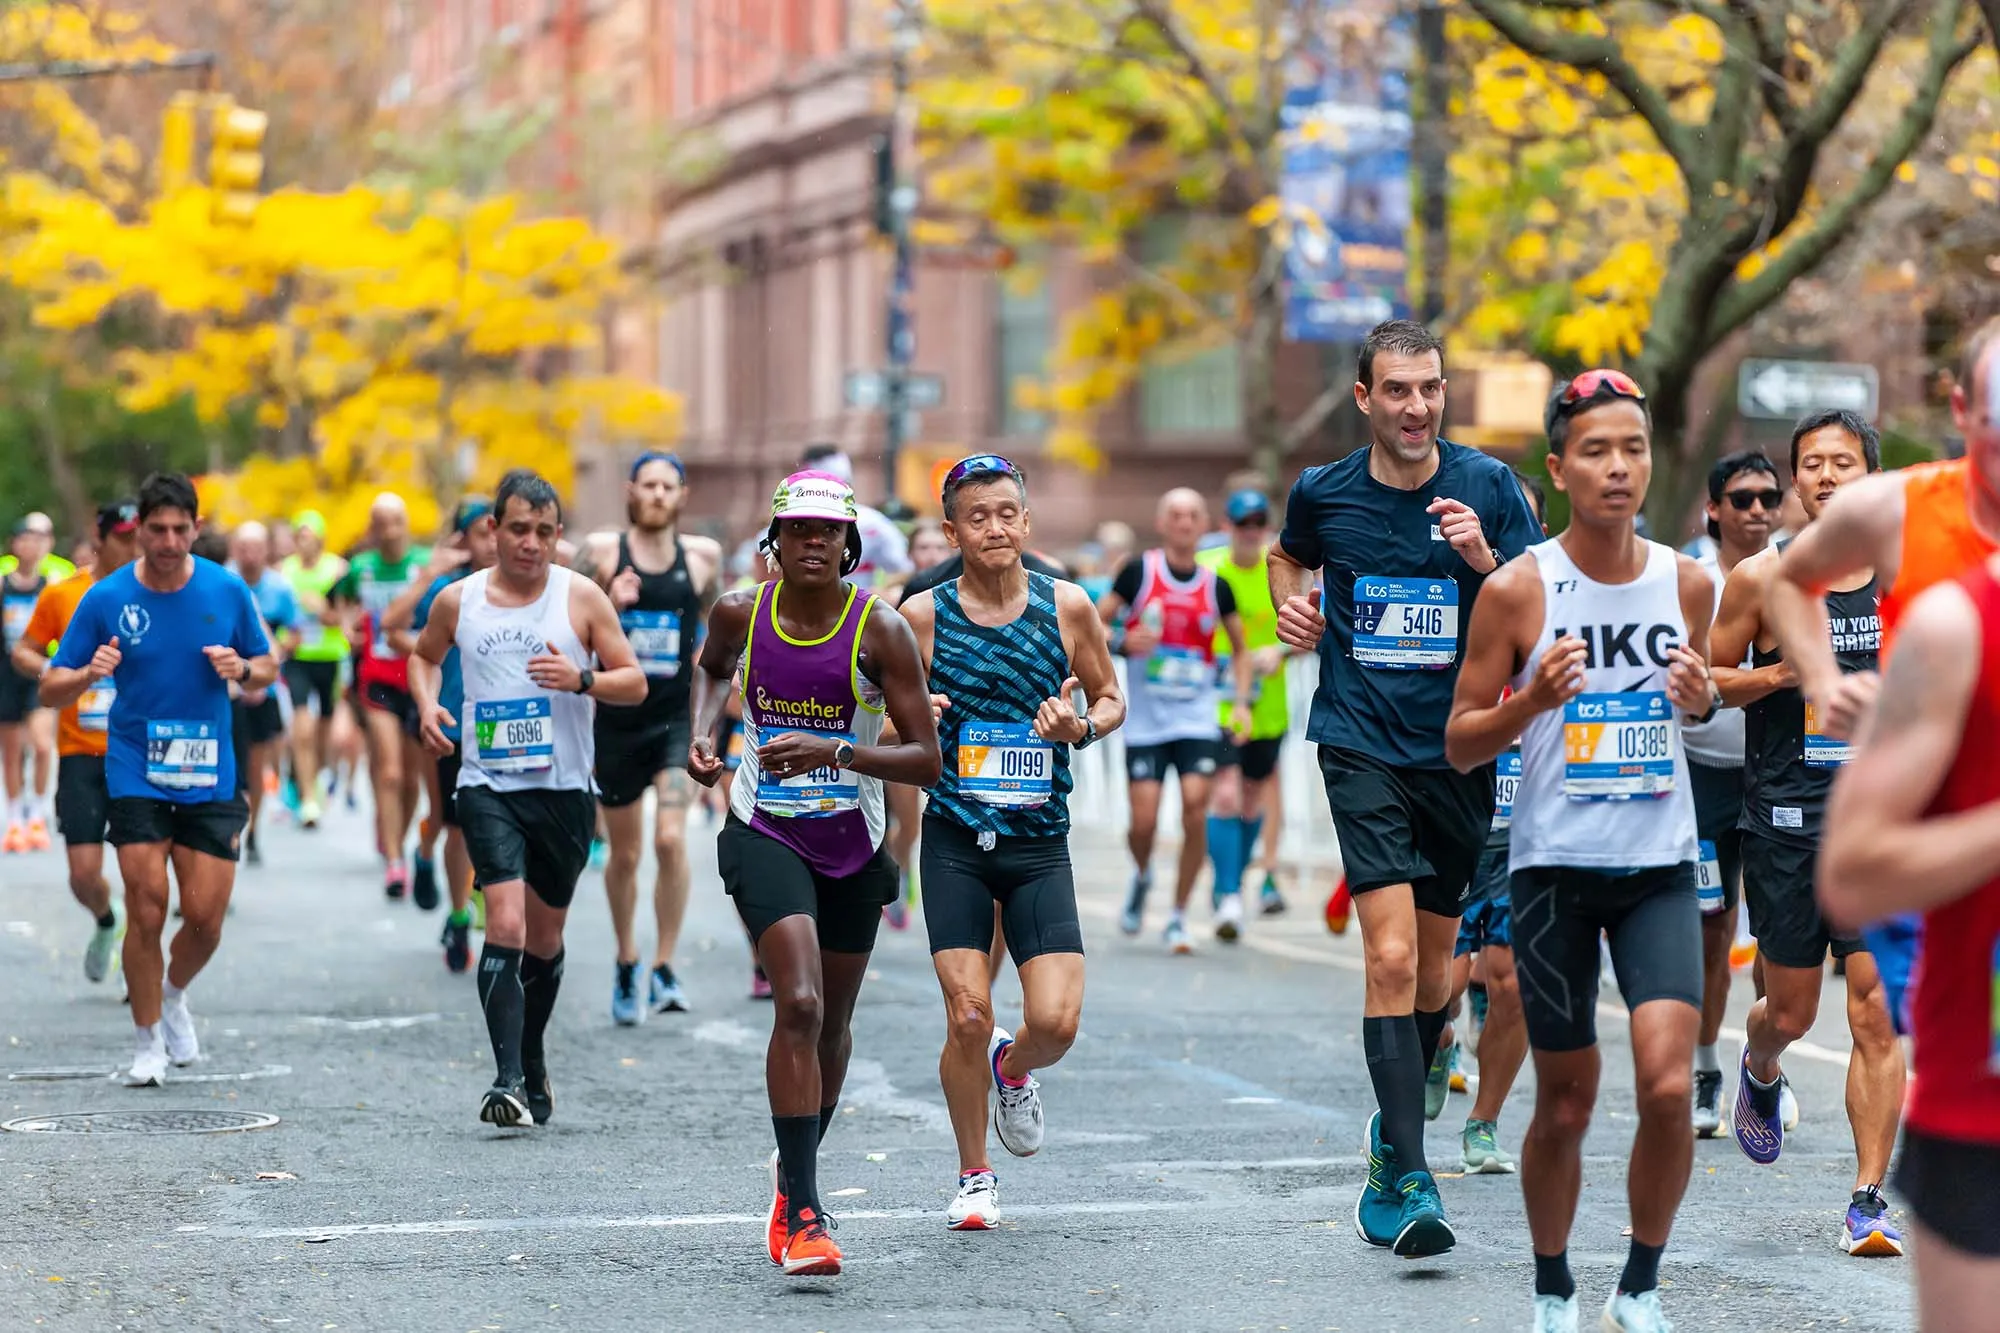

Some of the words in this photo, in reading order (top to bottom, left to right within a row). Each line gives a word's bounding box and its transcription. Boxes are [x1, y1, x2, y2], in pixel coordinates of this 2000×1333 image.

[1365, 583, 1387, 598] tcs
[1365, 620, 1374, 631] C
[1403, 607, 1442, 635] 5416
[1828, 618, 1845, 633] EW
[477, 629, 544, 656] CHICAGO
[1397, 640, 1421, 648] 2022
[757, 686, 843, 719] &mother
[1578, 702, 1604, 718] tcs
[762, 714, 811, 728] ATHLETIC
[814, 719, 845, 730] CLUB
[507, 720, 543, 744] 6698
[969, 728, 989, 742] tcs
[1618, 725, 1668, 760] 10389
[1001, 750, 1044, 778] 10199
[800, 788, 824, 797] 2022
